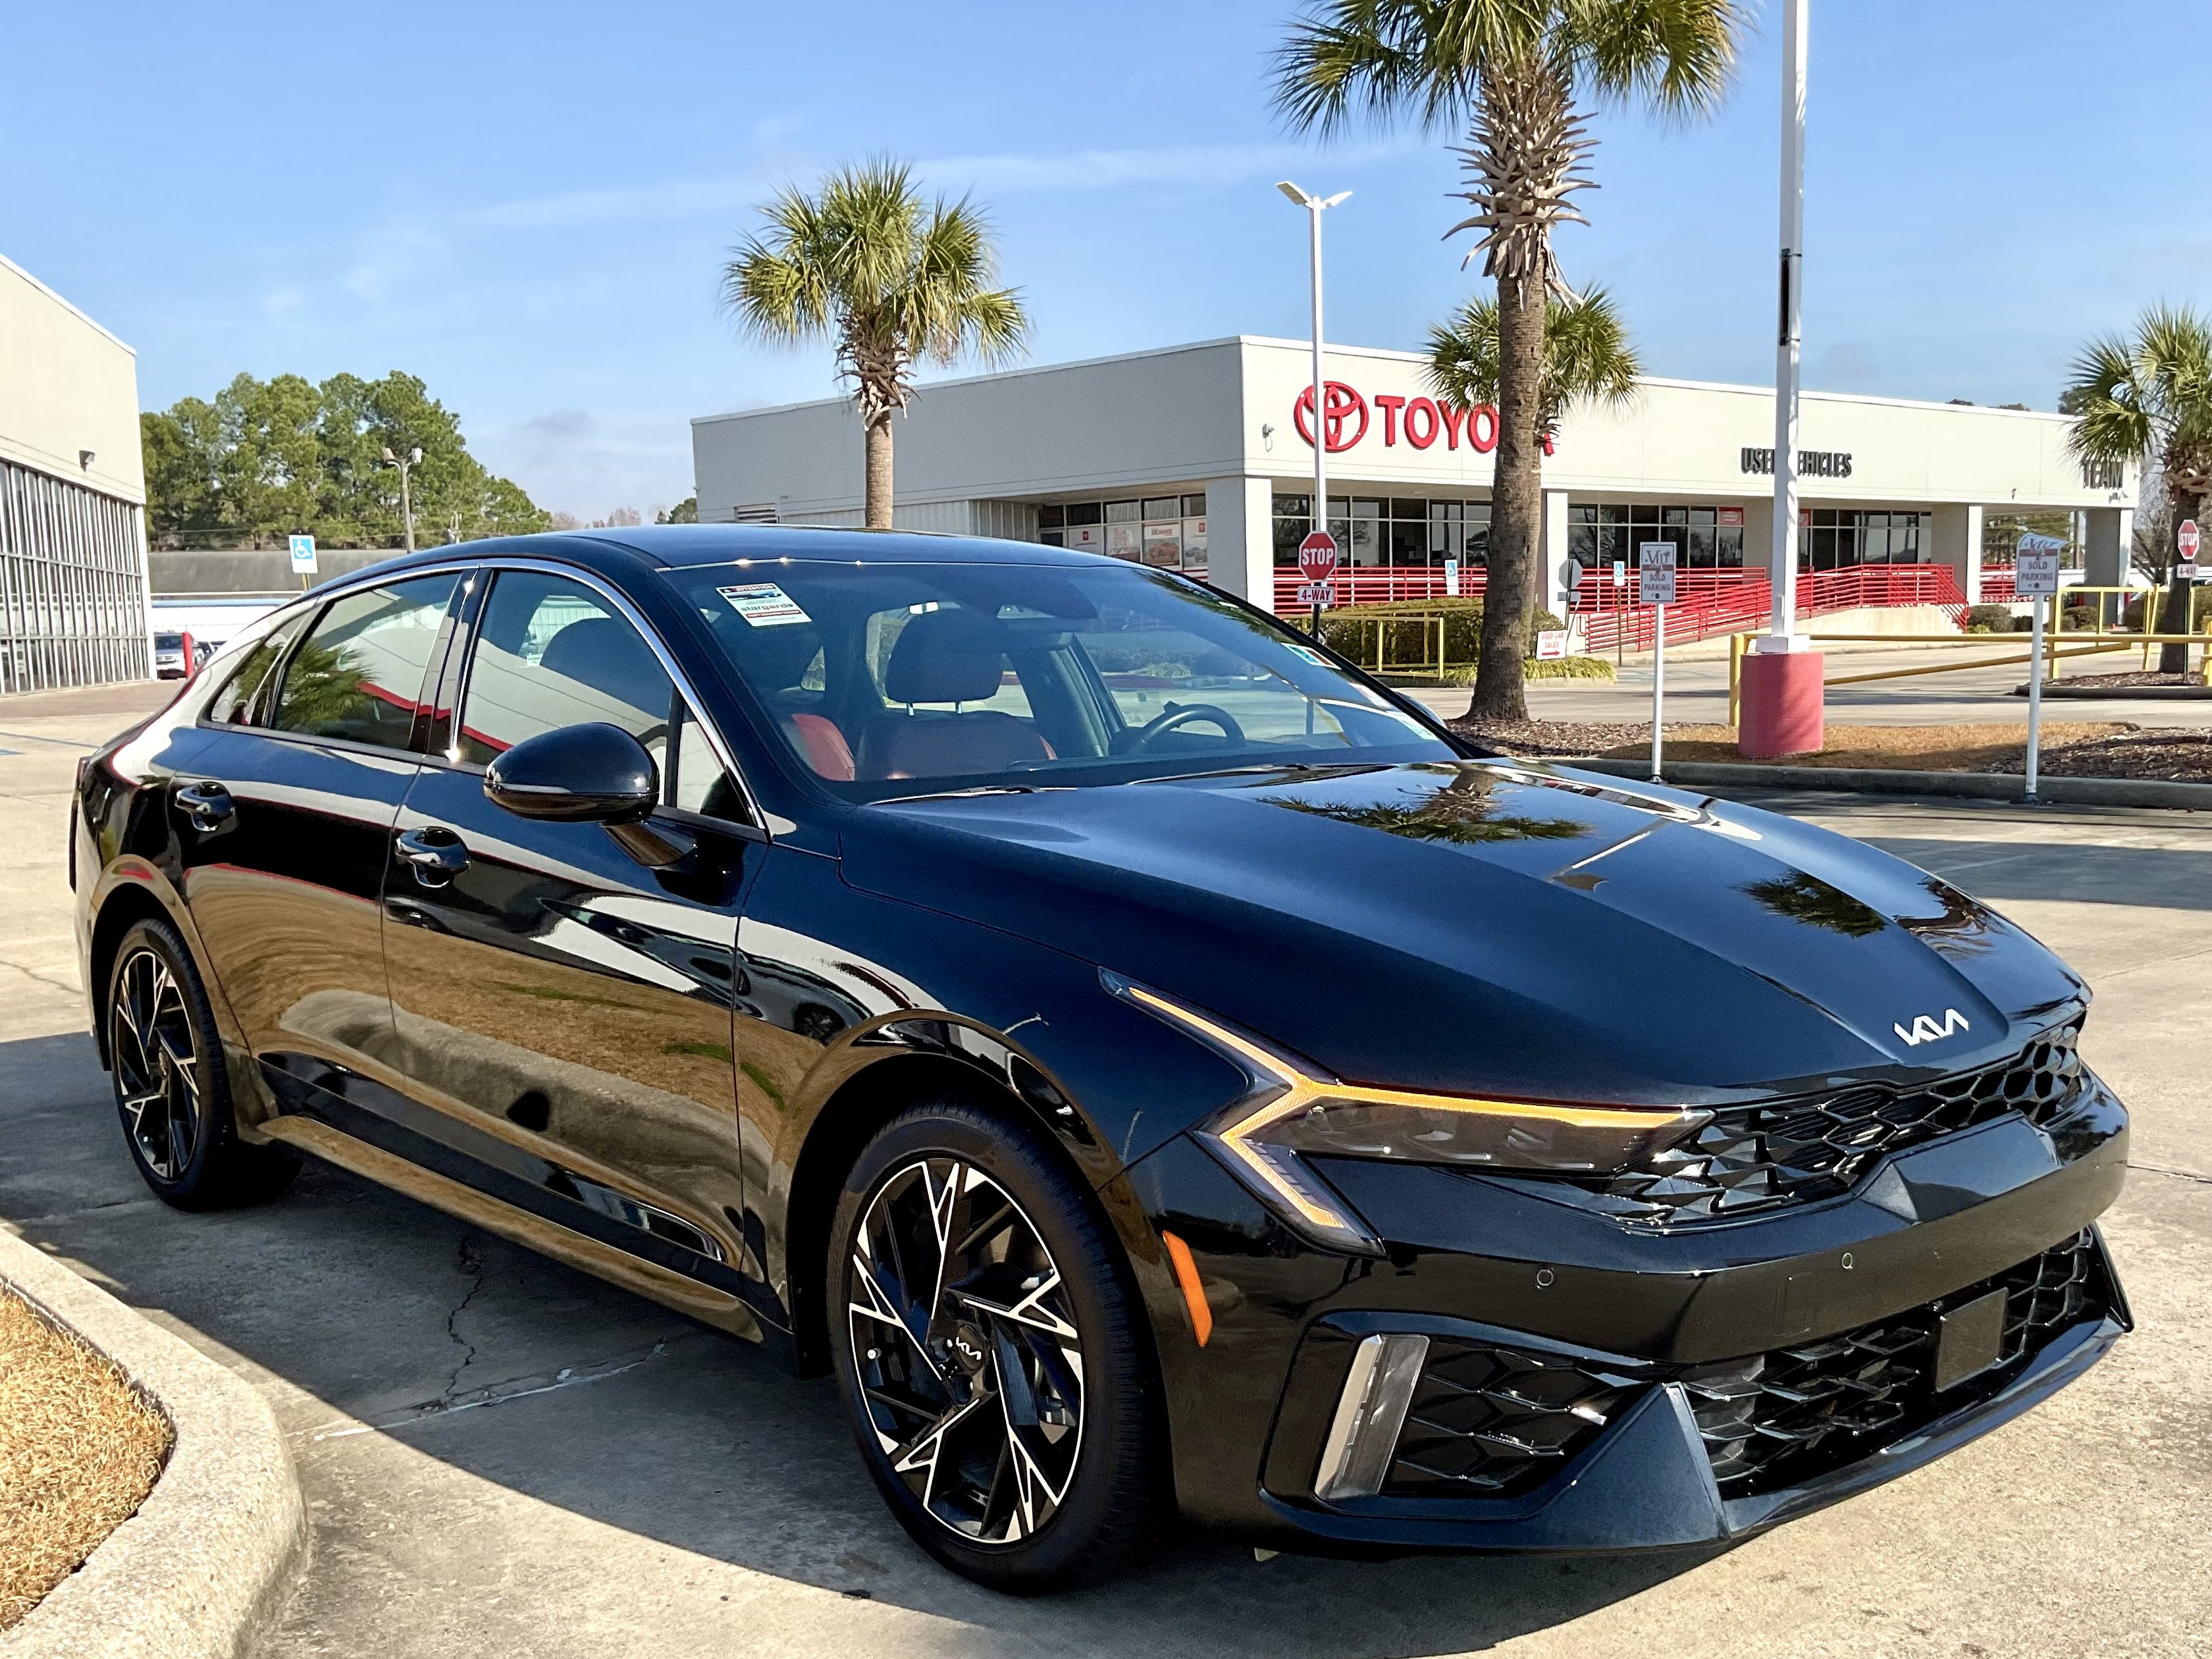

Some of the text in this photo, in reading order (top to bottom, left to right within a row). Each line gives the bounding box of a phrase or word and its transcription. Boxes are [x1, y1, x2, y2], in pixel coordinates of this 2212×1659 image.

[1375, 395, 1555, 457] TOYO
[1741, 448, 1852, 478] USE EHICLES
[2180, 533, 2198, 546] STOP
[1302, 548, 1334, 566] STOP
[2028, 561, 2047, 569] SOLD
[2180, 566, 2197, 575] 4-WAY
[1302, 589, 1330, 601] 4-WAY
